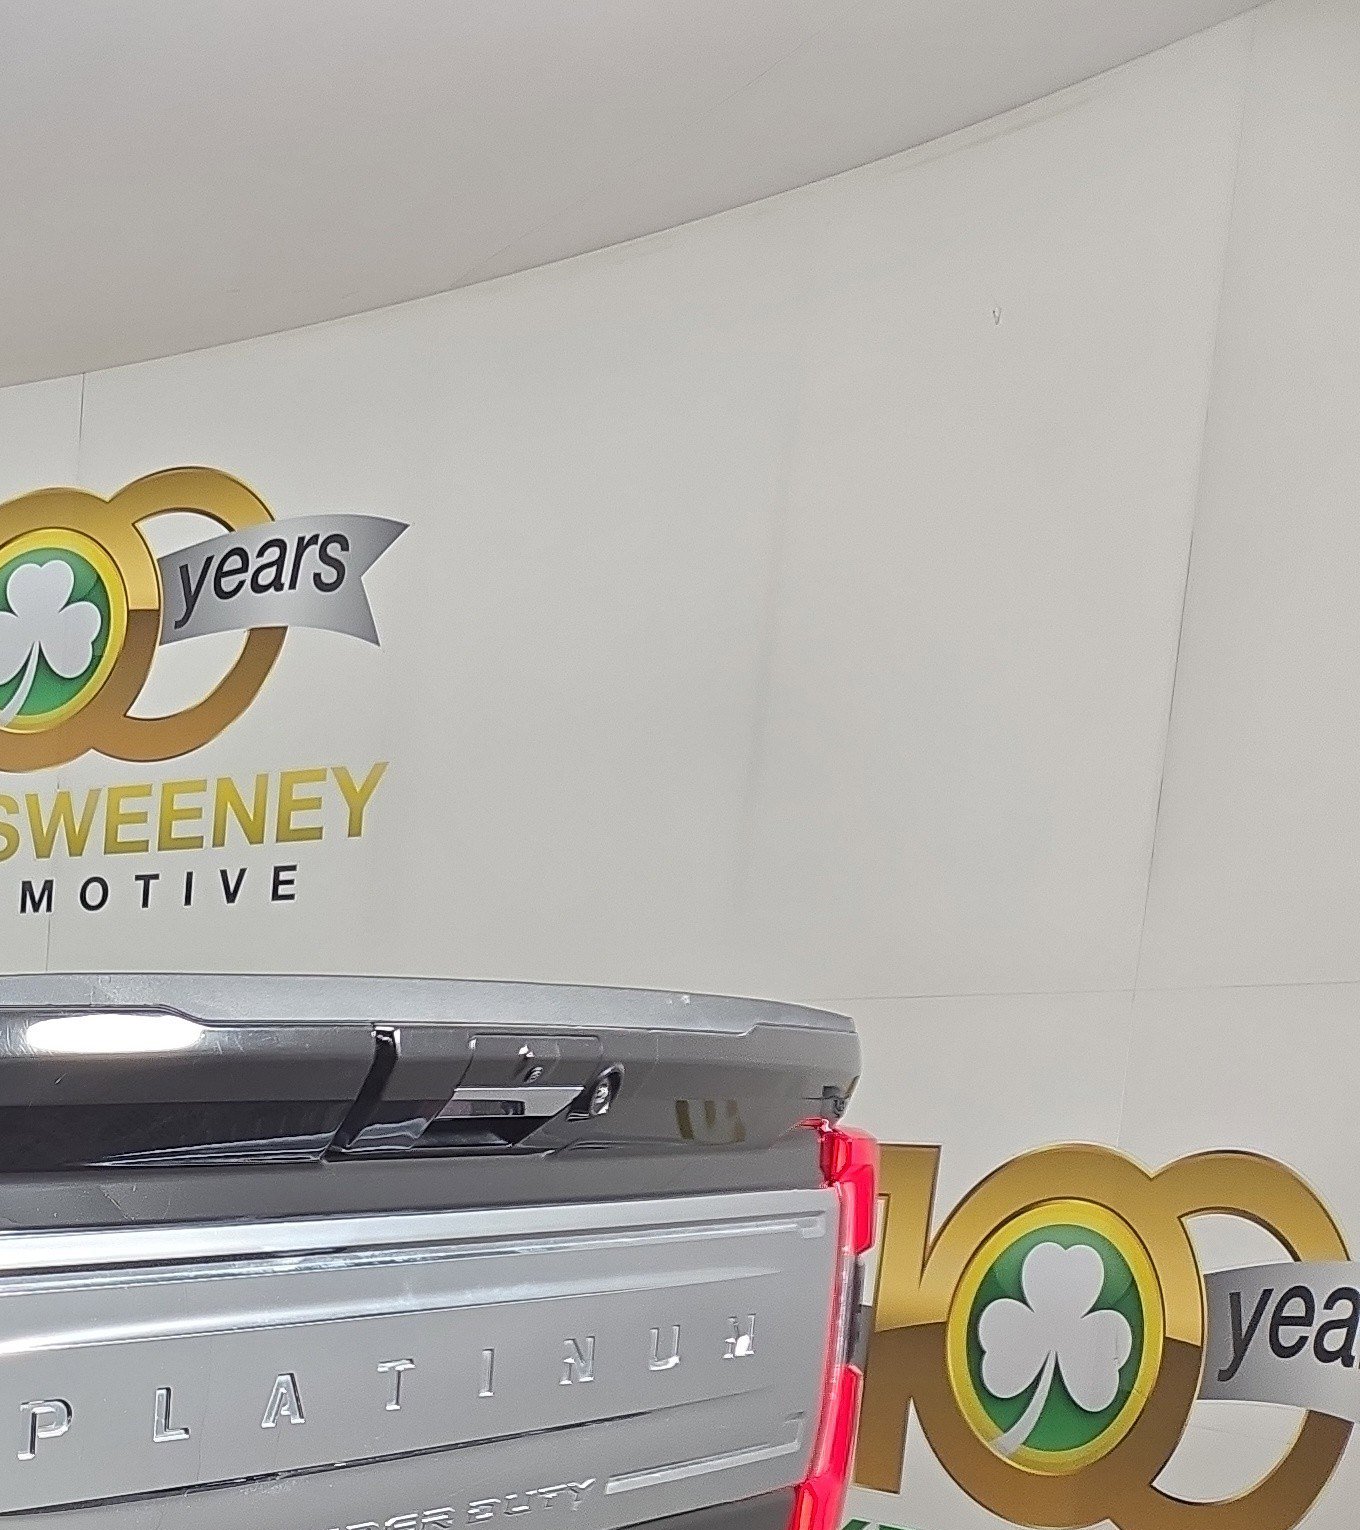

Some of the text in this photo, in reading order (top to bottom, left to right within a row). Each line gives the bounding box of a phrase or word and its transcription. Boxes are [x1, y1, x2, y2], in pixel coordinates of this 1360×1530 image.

[174, 531, 351, 631] years
[1217, 1285, 1360, 1382] yea
[17, 1312, 757, 1461] PLATINUM
[466, 1478, 598, 1525] DUTY
